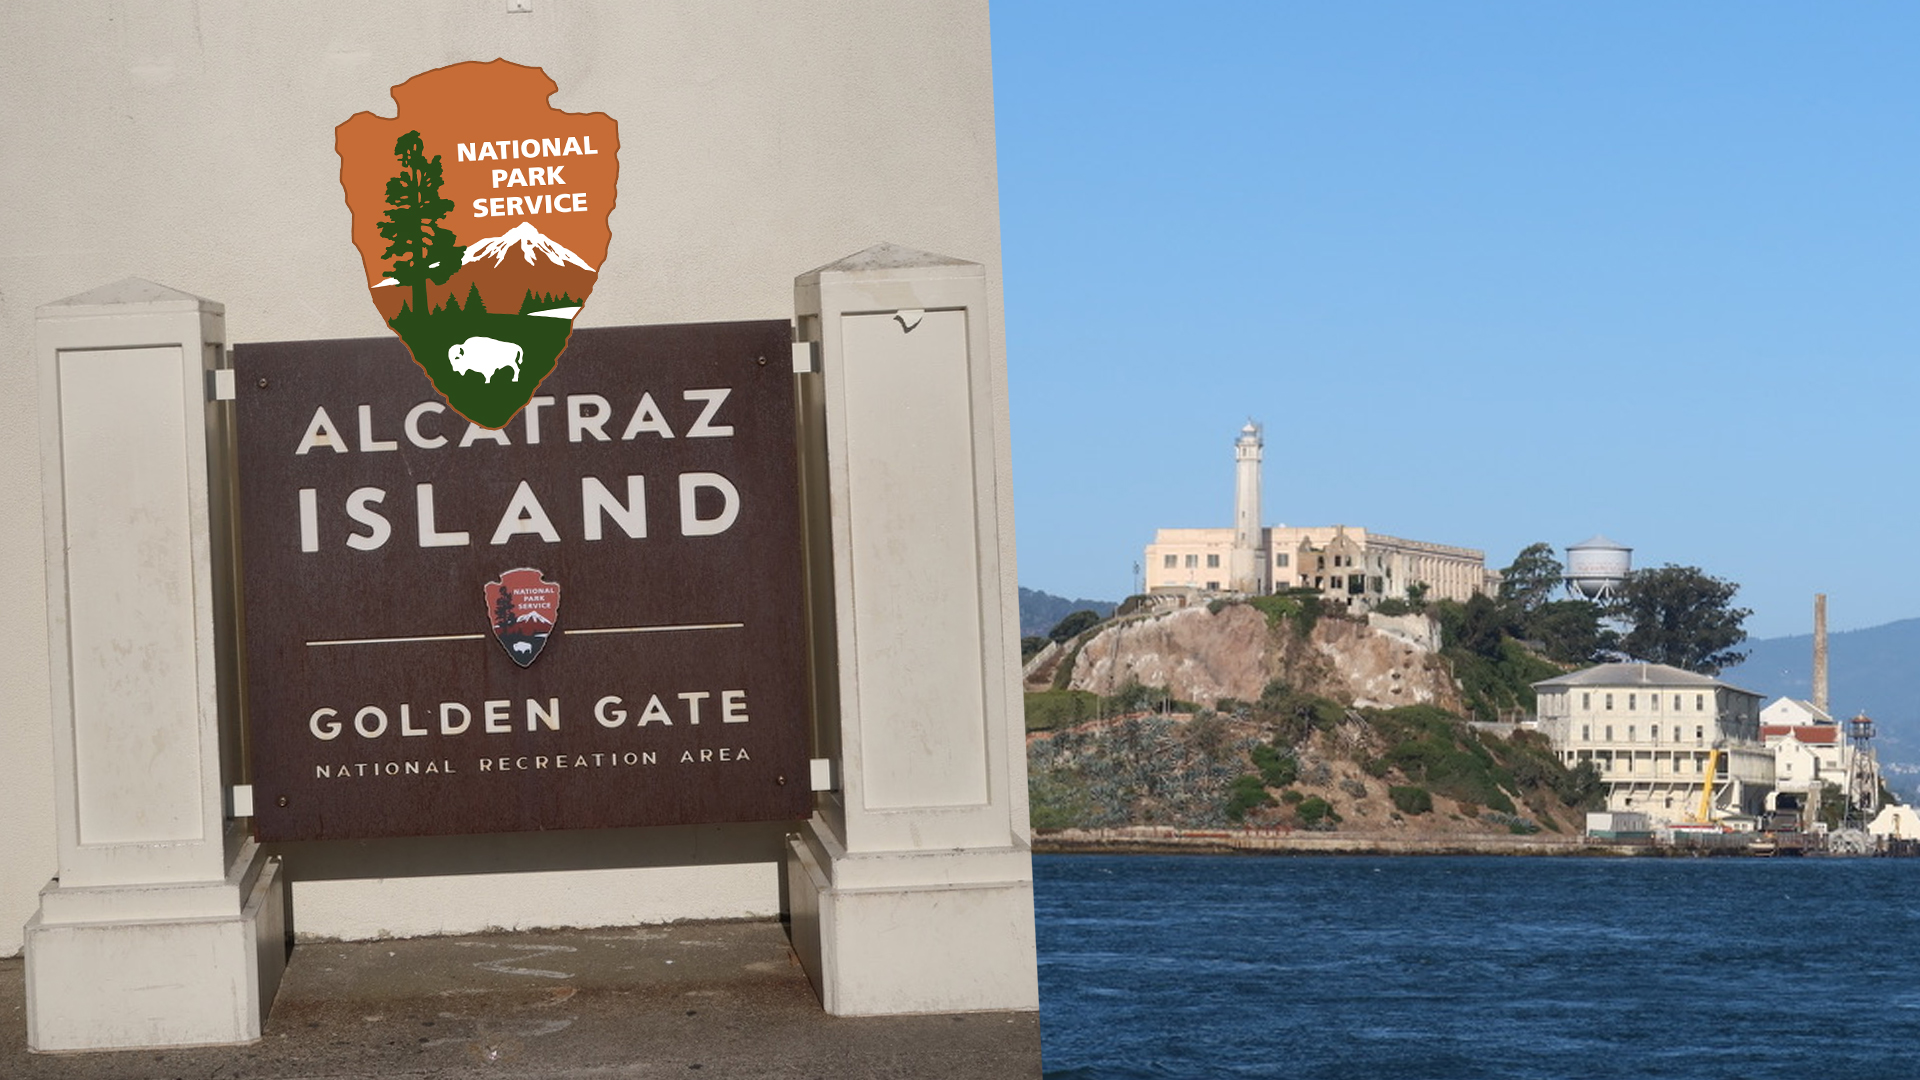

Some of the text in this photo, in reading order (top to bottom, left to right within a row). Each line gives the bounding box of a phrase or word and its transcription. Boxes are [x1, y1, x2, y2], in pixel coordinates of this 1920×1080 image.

[299, 472, 741, 553] ISLAND
[513, 587, 555, 595] NATIONAL
[309, 690, 750, 740] GOLDEN GATE
[316, 748, 751, 779] NATIONAL RECREATION AREA
